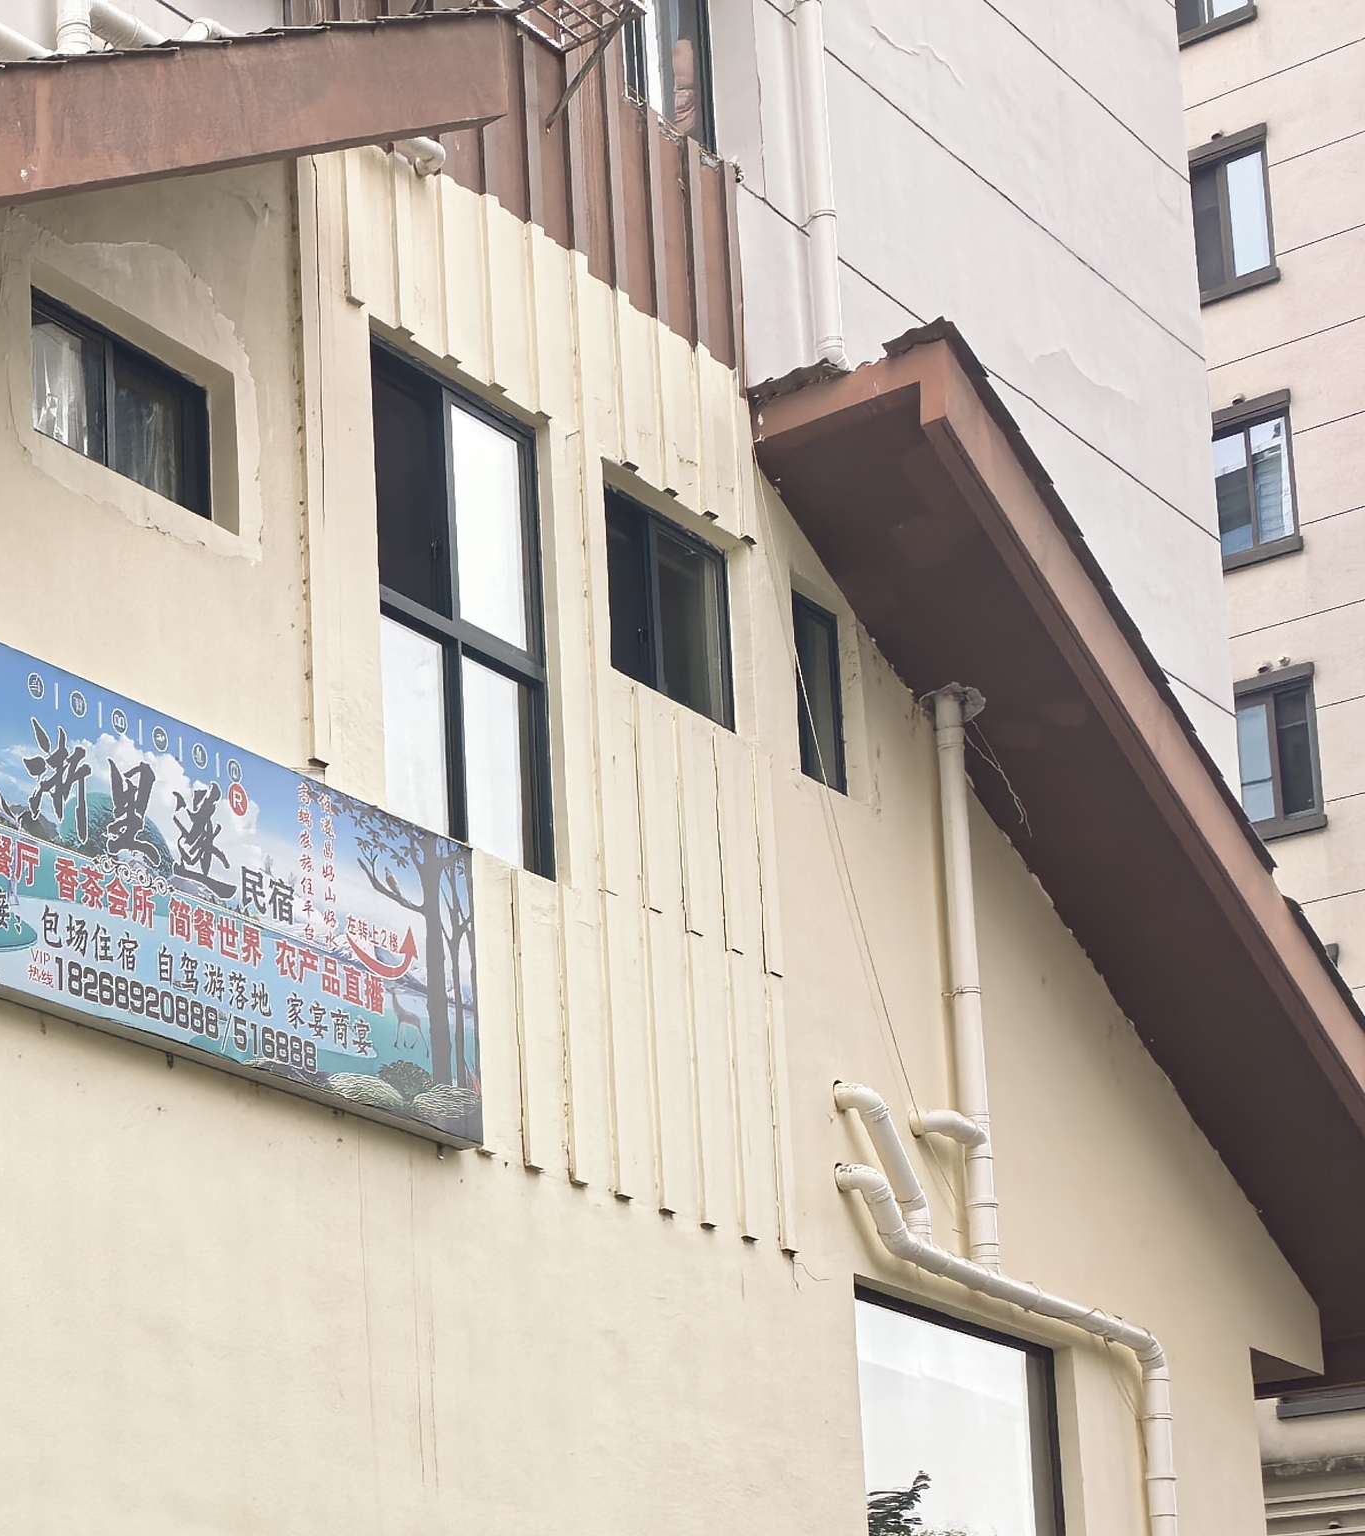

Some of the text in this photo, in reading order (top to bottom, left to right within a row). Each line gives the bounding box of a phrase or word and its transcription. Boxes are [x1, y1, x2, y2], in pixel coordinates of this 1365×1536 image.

[240, 865, 295, 925] 民宿
[30, 948, 52, 966] VIP
[54, 857, 157, 930] 香茶会所
[168, 898, 264, 969] 简餐世界
[275, 939, 386, 1017] 农产品直播
[27, 964, 55, 989] 热线
[40, 903, 139, 974] 包场住宿
[156, 944, 273, 1019] 自驾游落地
[286, 991, 375, 1056] 家宴商宴
